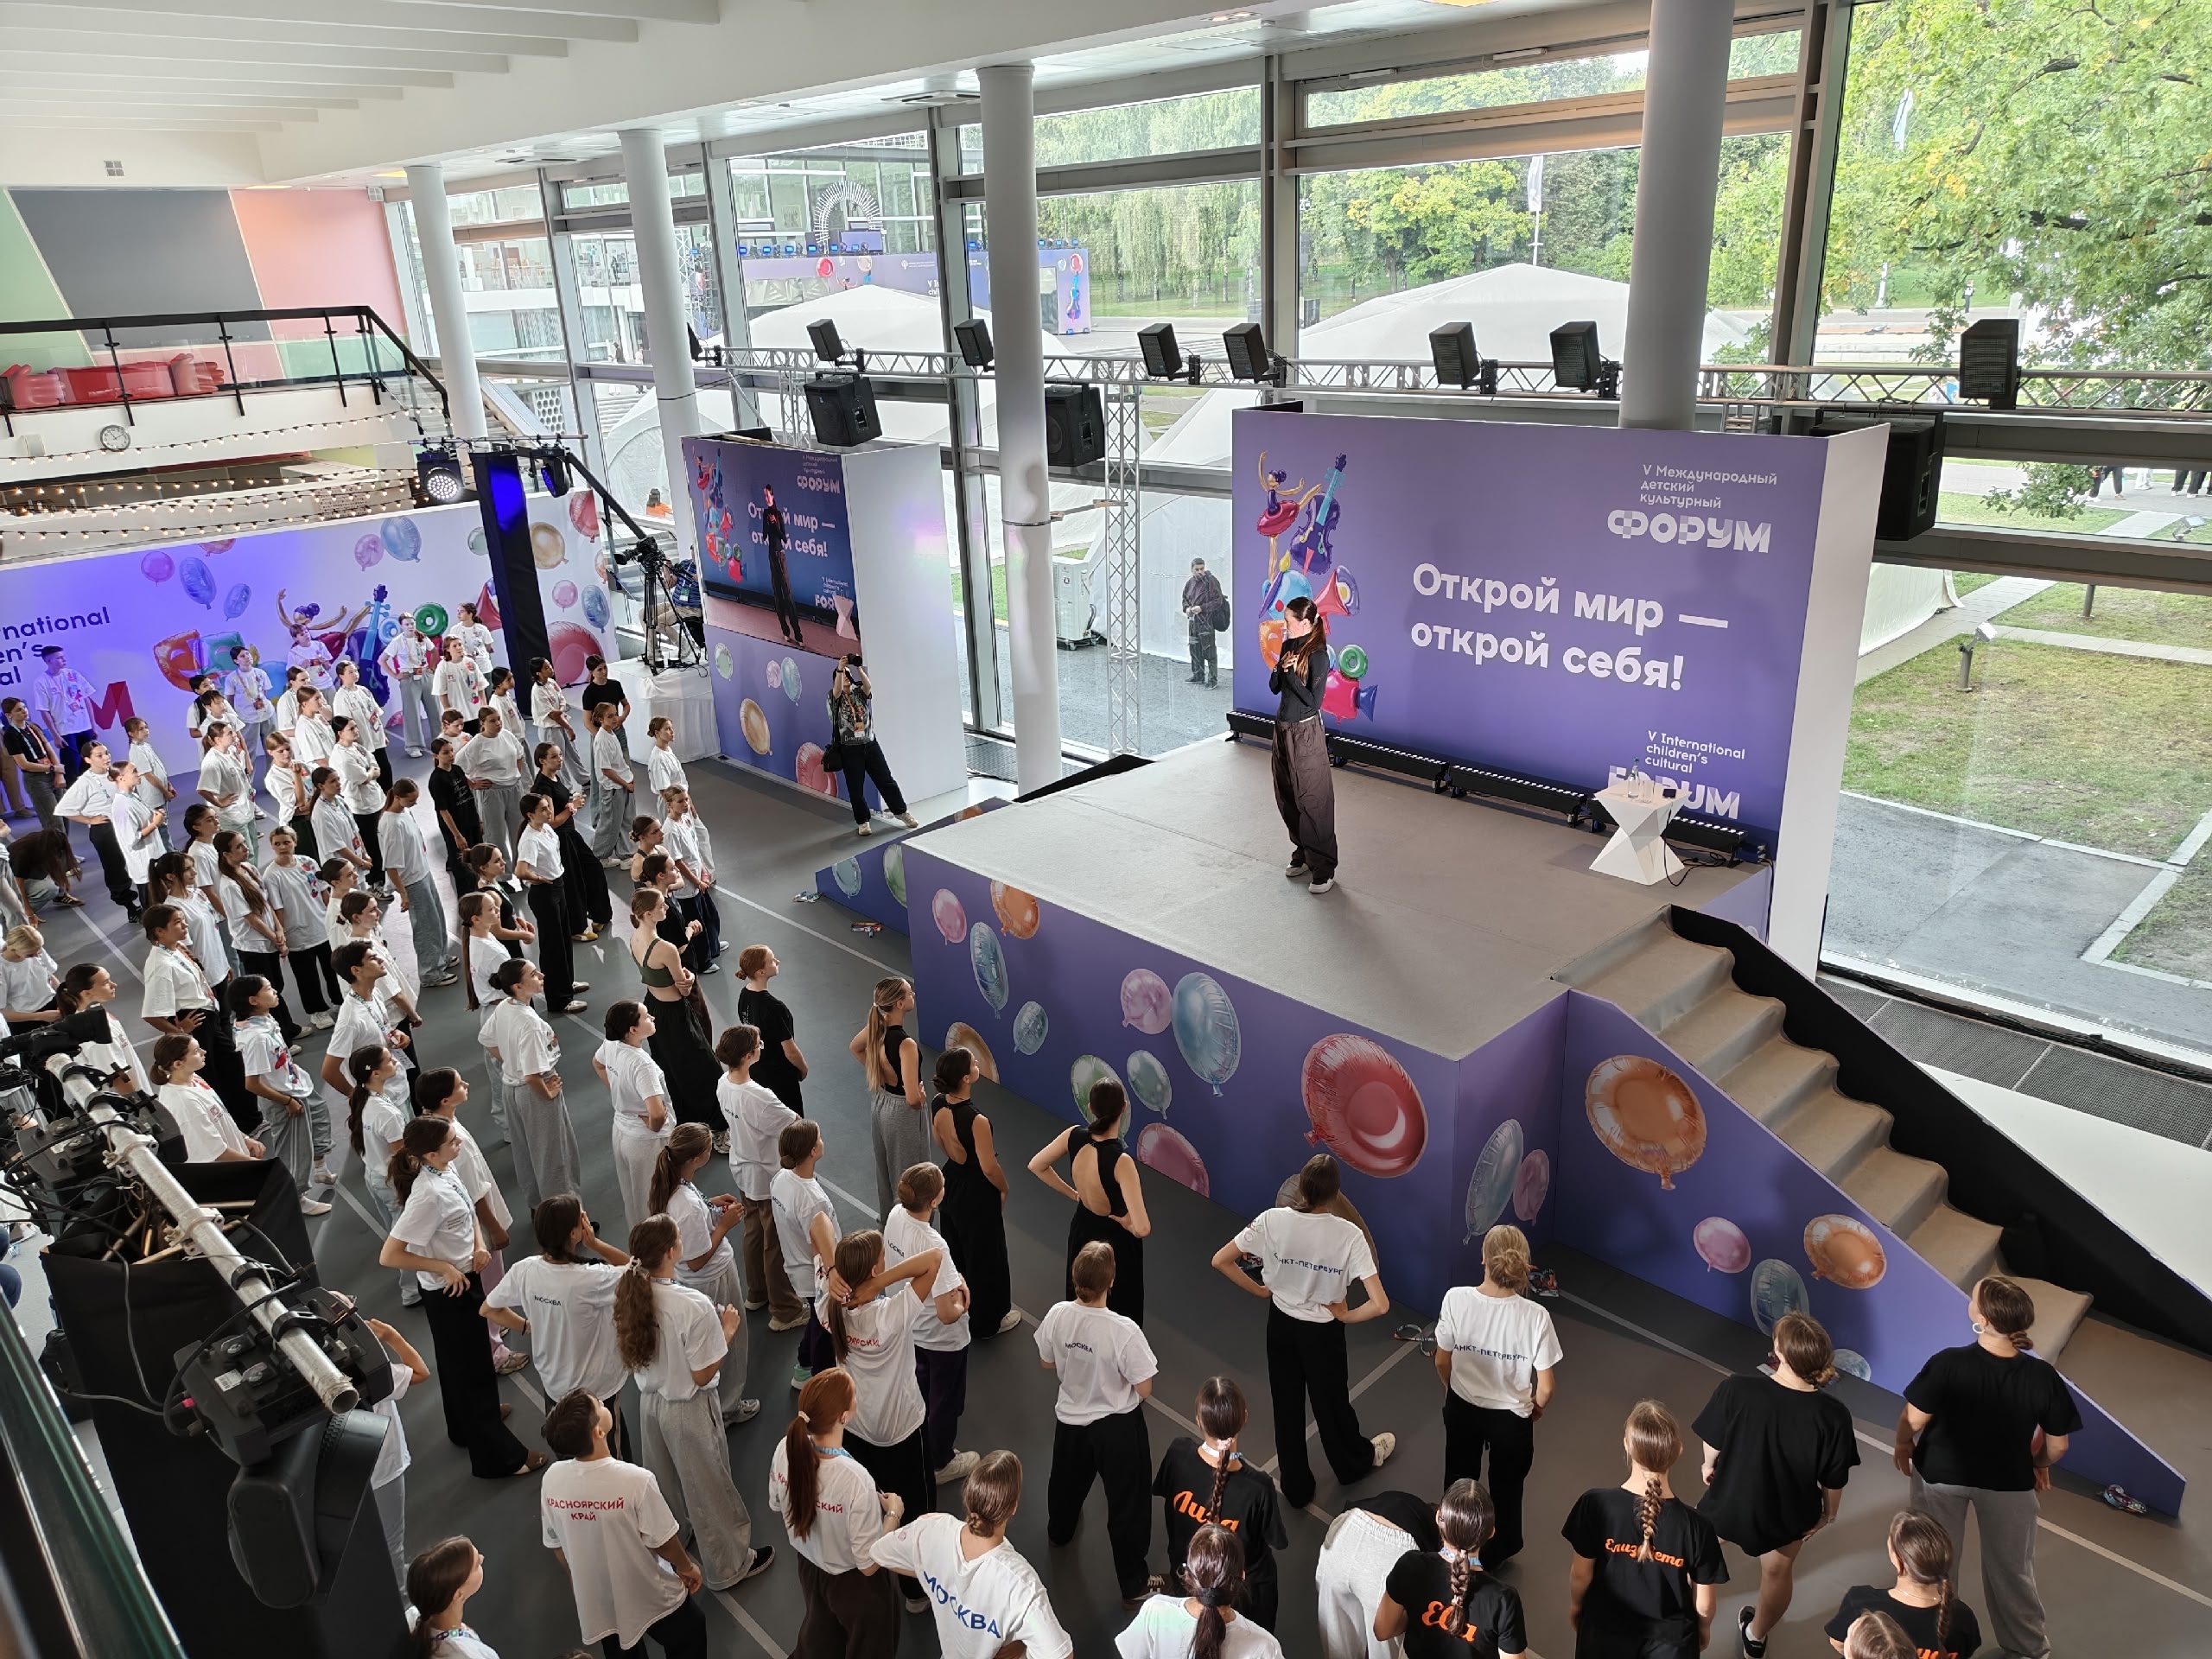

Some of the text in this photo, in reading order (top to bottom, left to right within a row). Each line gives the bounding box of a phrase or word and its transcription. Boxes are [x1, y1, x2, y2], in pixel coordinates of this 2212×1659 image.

[798, 475, 840, 493] ФОРУМ
[1656, 465, 1777, 485] Международный
[1640, 480, 1694, 493] детский
[1639, 493, 1722, 509] культурный
[793, 513, 818, 533] мир
[1607, 509, 1771, 553] ФОРУМ
[795, 537, 829, 557] себя!
[1413, 563, 1560, 614] Открой
[1573, 589, 1663, 636] мир
[0, 607, 111, 640] national
[1411, 621, 1684, 691] открой себя!
[1646, 744, 1708, 765] children's
[1648, 730, 1745, 760] V International
[1644, 756, 1693, 773] cultural
[1274, 1252, 1344, 1275] СНКТ-ПЕТЕРБУРГ
[1452, 1344, 1529, 1362] АНКТ-ПЕТЕРБУРГ
[546, 1497, 625, 1510] КРАСНОЯРСКИЙ
[1173, 1491, 1240, 1533] Лиа
[570, 1510, 597, 1522] КРАЙ
[1605, 1538, 1684, 1567] Елизета
[923, 1570, 1001, 1638] МОСКВА
